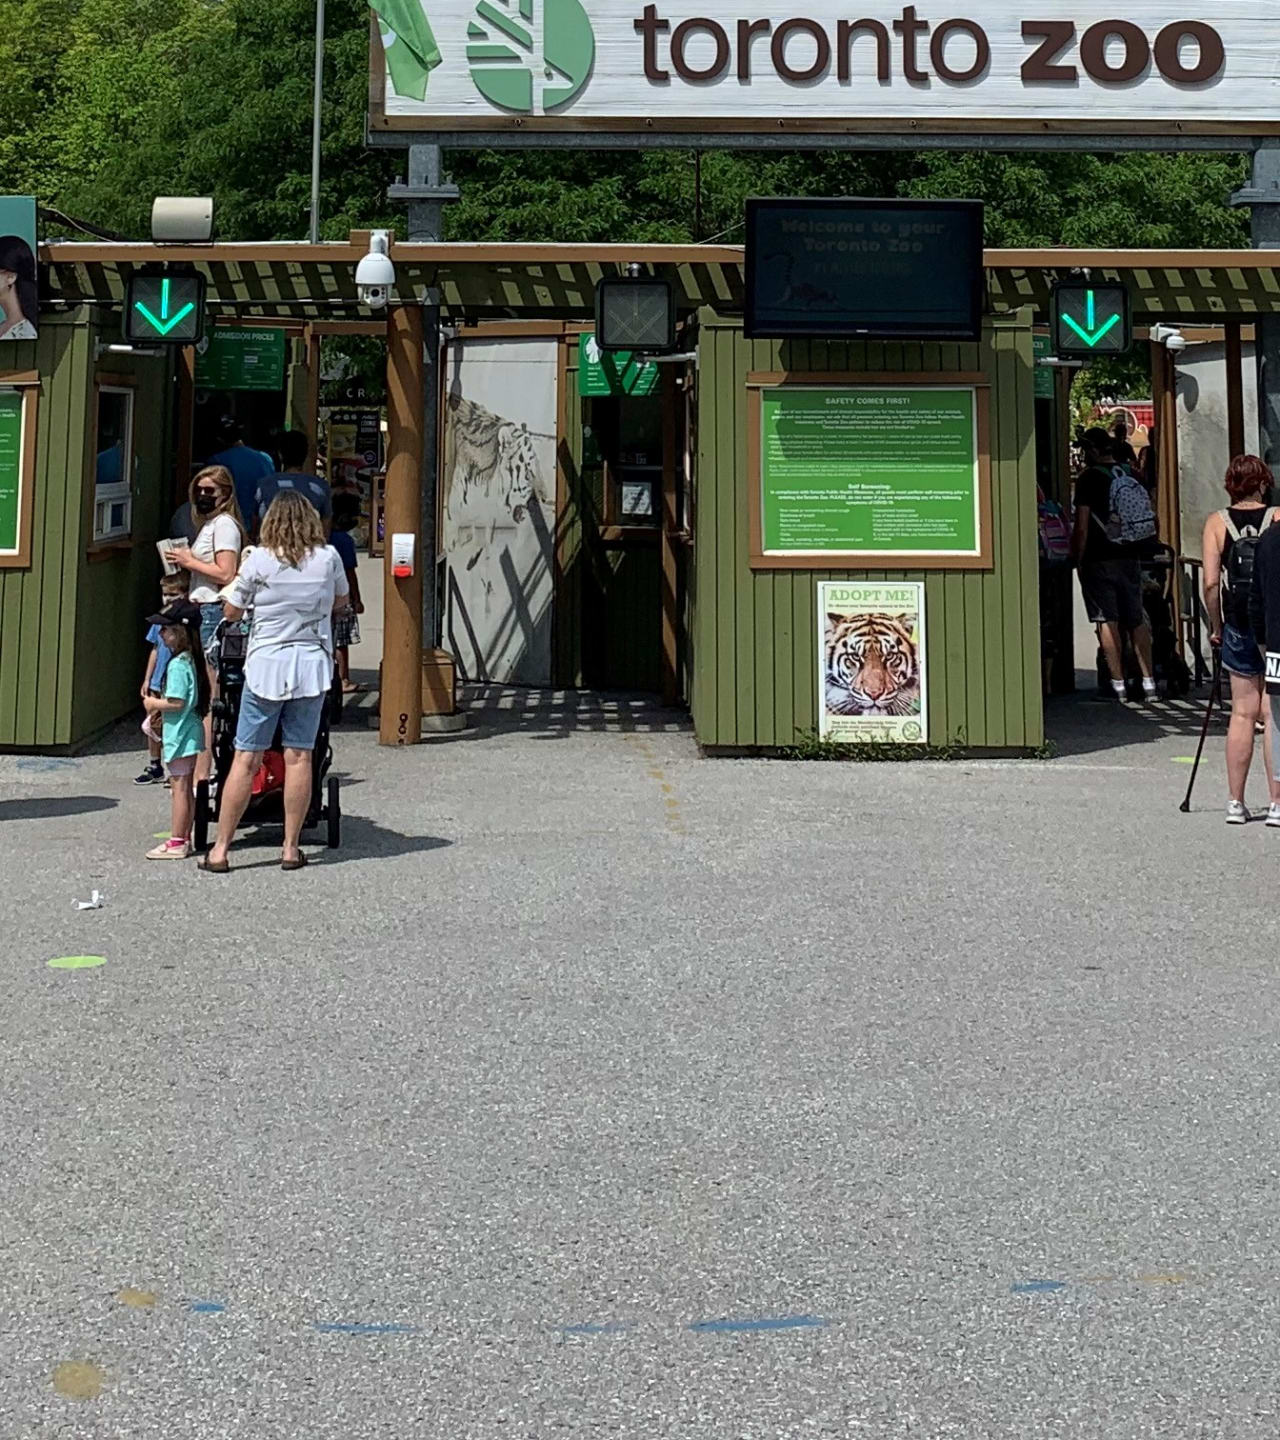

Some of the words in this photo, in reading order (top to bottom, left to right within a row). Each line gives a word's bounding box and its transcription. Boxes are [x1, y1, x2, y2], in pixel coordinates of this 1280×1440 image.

[633, 4, 992, 83] toronto
[1020, 18, 1226, 85] zoo
[781, 219, 865, 233] Welcome
[888, 239, 924, 253] Zoo
[825, 397, 854, 405] SAFETY
[857, 397, 884, 405] COMES
[886, 397, 910, 405] FIRST!
[830, 589, 882, 601] ADOPT
[885, 589, 914, 601] ME!
